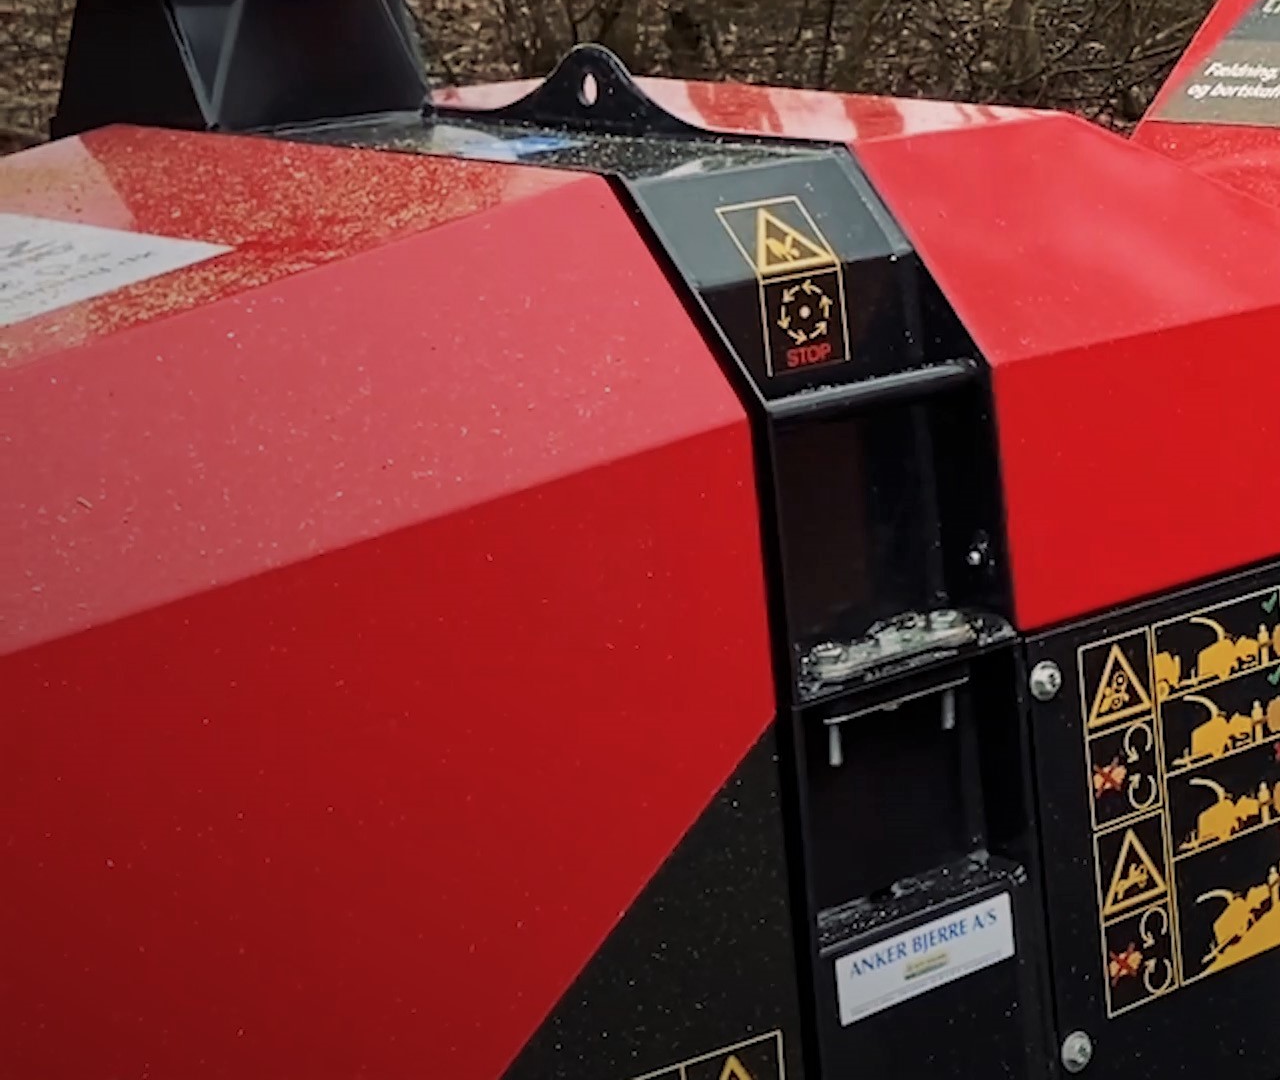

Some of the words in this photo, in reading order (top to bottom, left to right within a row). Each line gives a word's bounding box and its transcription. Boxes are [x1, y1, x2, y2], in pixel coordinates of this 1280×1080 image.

[1186, 83, 1213, 100] og
[786, 342, 832, 368] STOP
[851, 941, 908, 979] ANKER
[912, 917, 969, 955] BJERRE
